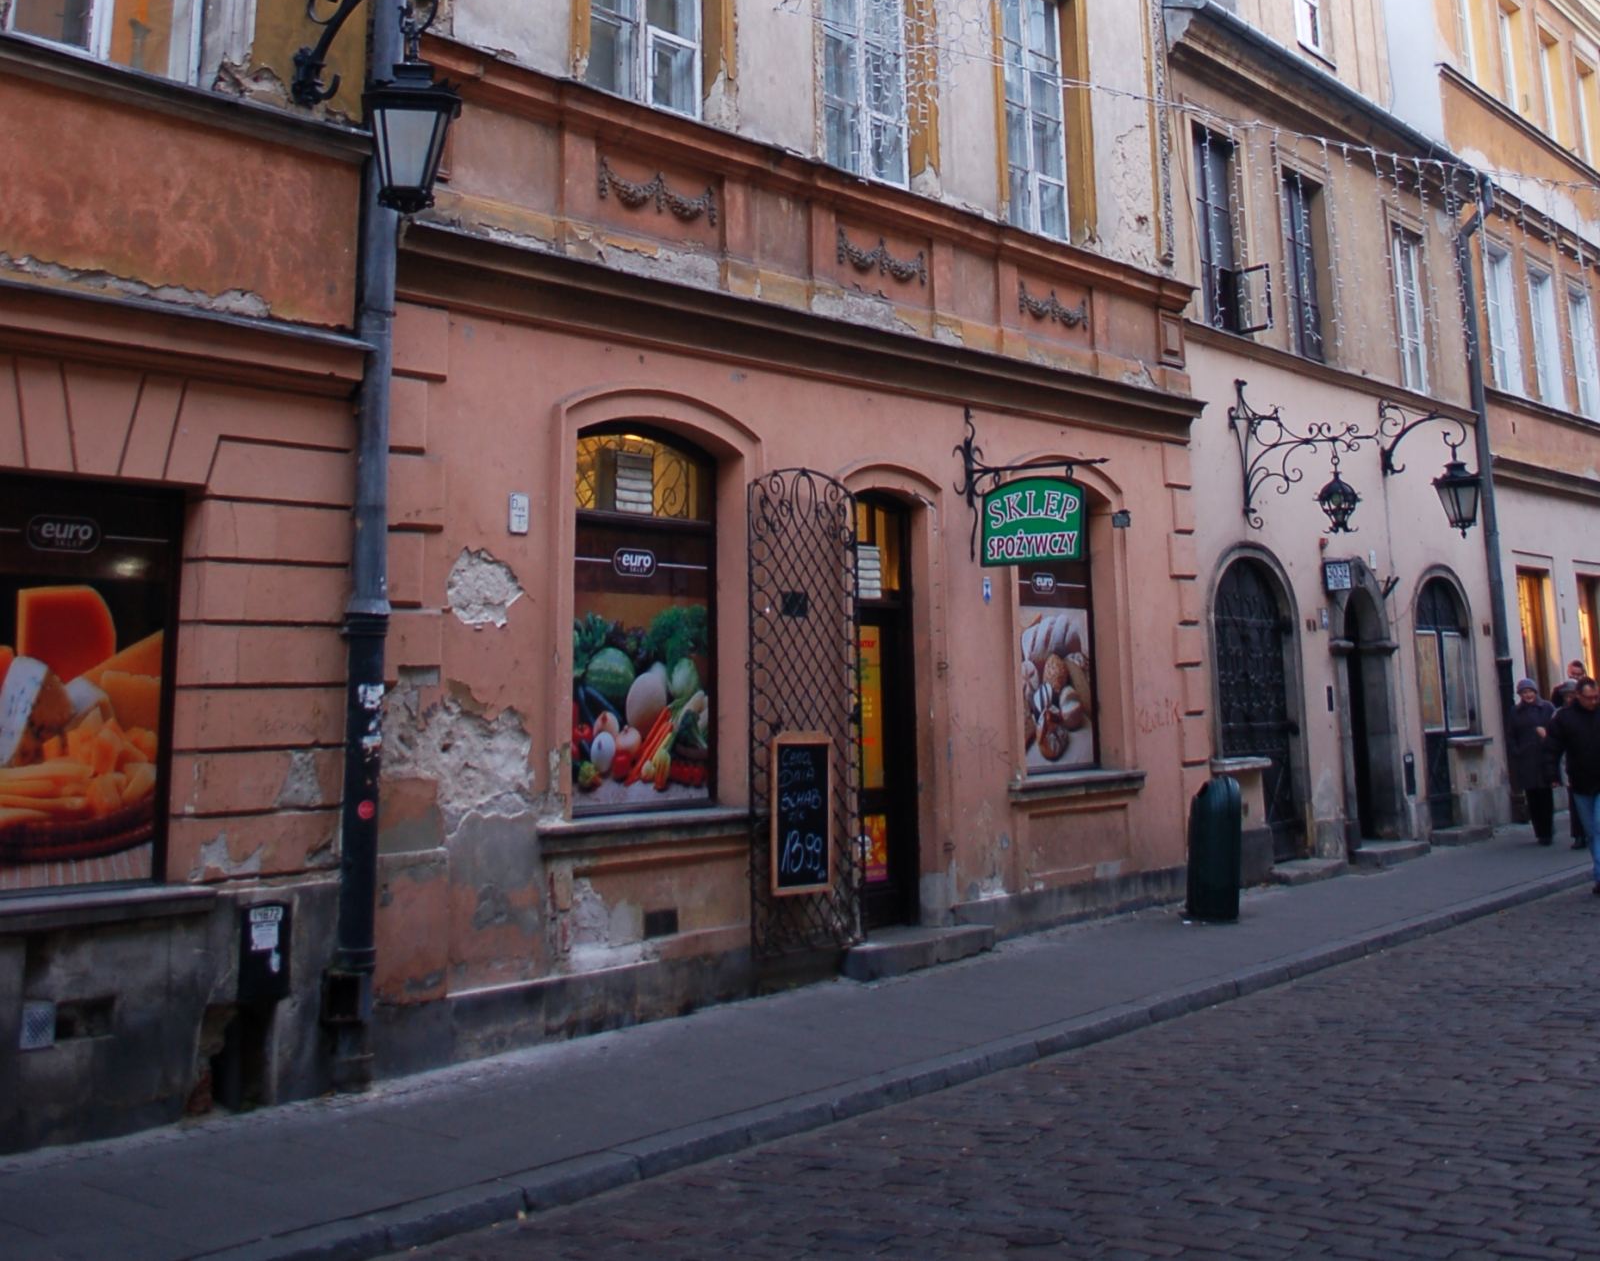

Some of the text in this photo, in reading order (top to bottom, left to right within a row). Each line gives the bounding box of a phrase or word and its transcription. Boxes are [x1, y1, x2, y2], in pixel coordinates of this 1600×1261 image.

[988, 490, 1079, 528] SKLEP
[41, 522, 93, 540] euro
[988, 529, 1077, 559] SPOŻYWCZY
[622, 553, 652, 568] euro
[1036, 577, 1053, 587] euro
